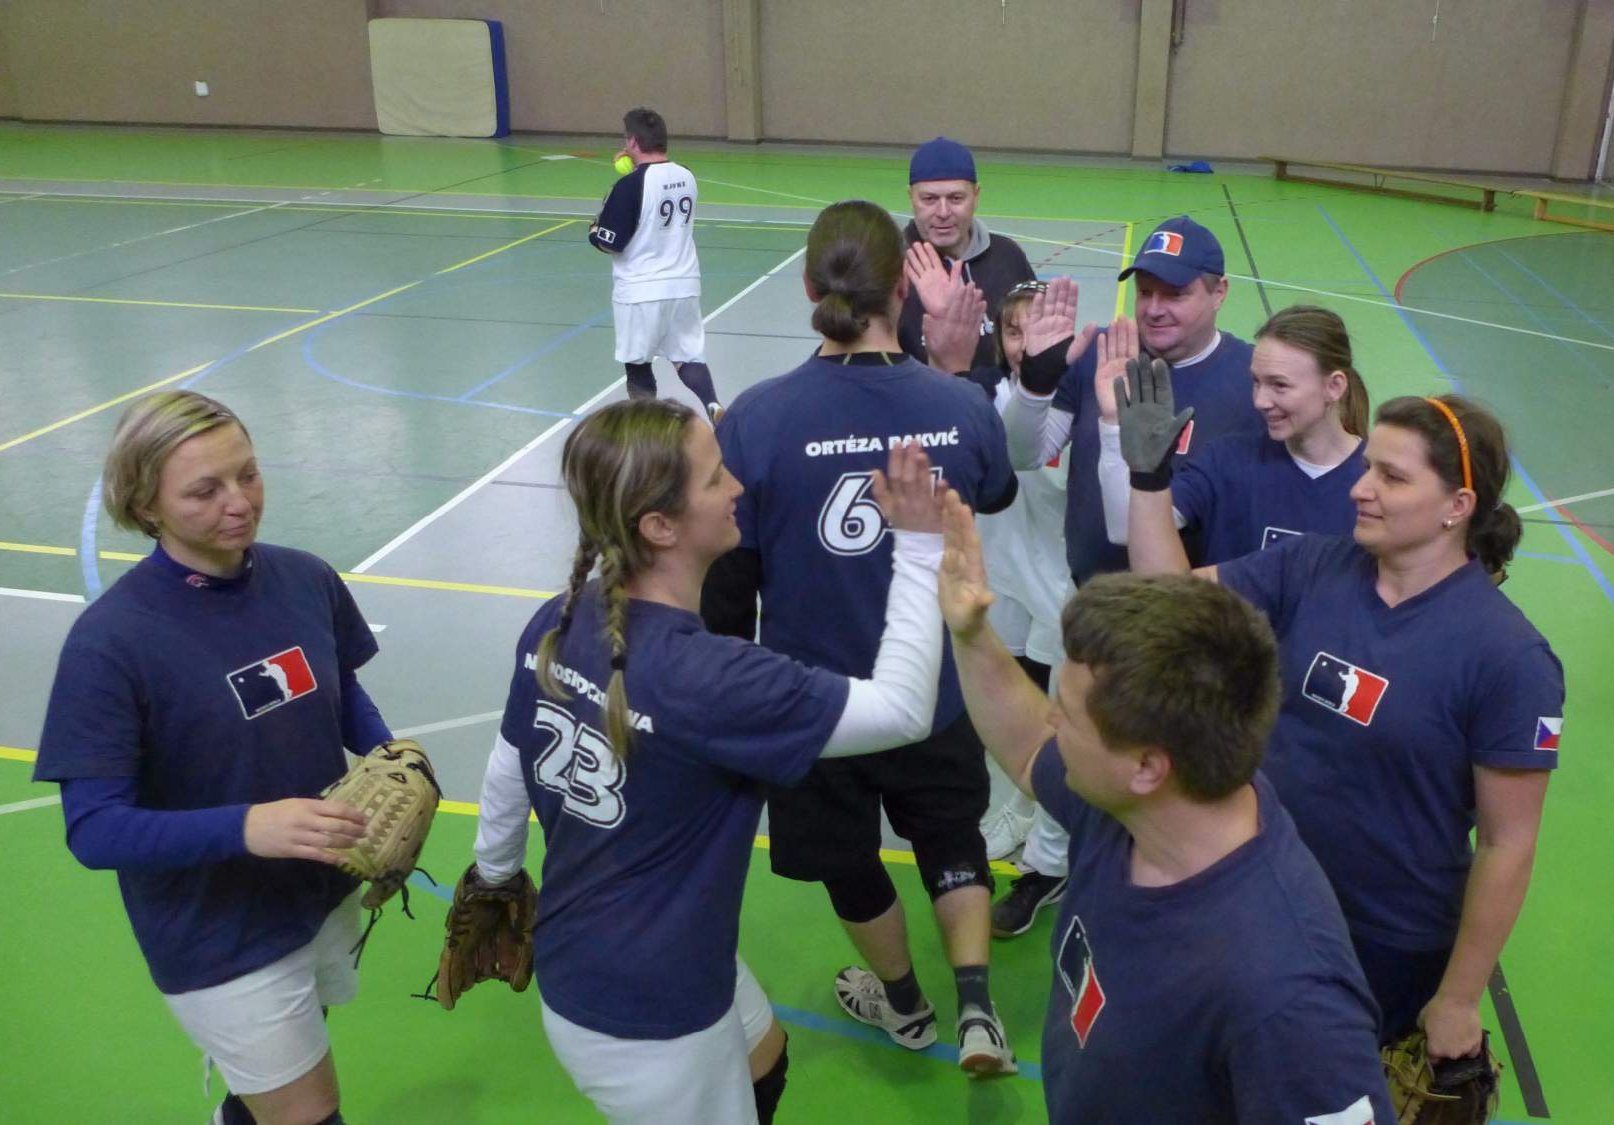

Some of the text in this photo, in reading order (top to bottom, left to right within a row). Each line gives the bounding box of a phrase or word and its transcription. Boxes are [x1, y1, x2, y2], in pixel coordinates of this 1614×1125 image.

[659, 196, 693, 227] 99
[805, 434, 884, 457] ORTÉZA
[533, 699, 627, 829] 23
